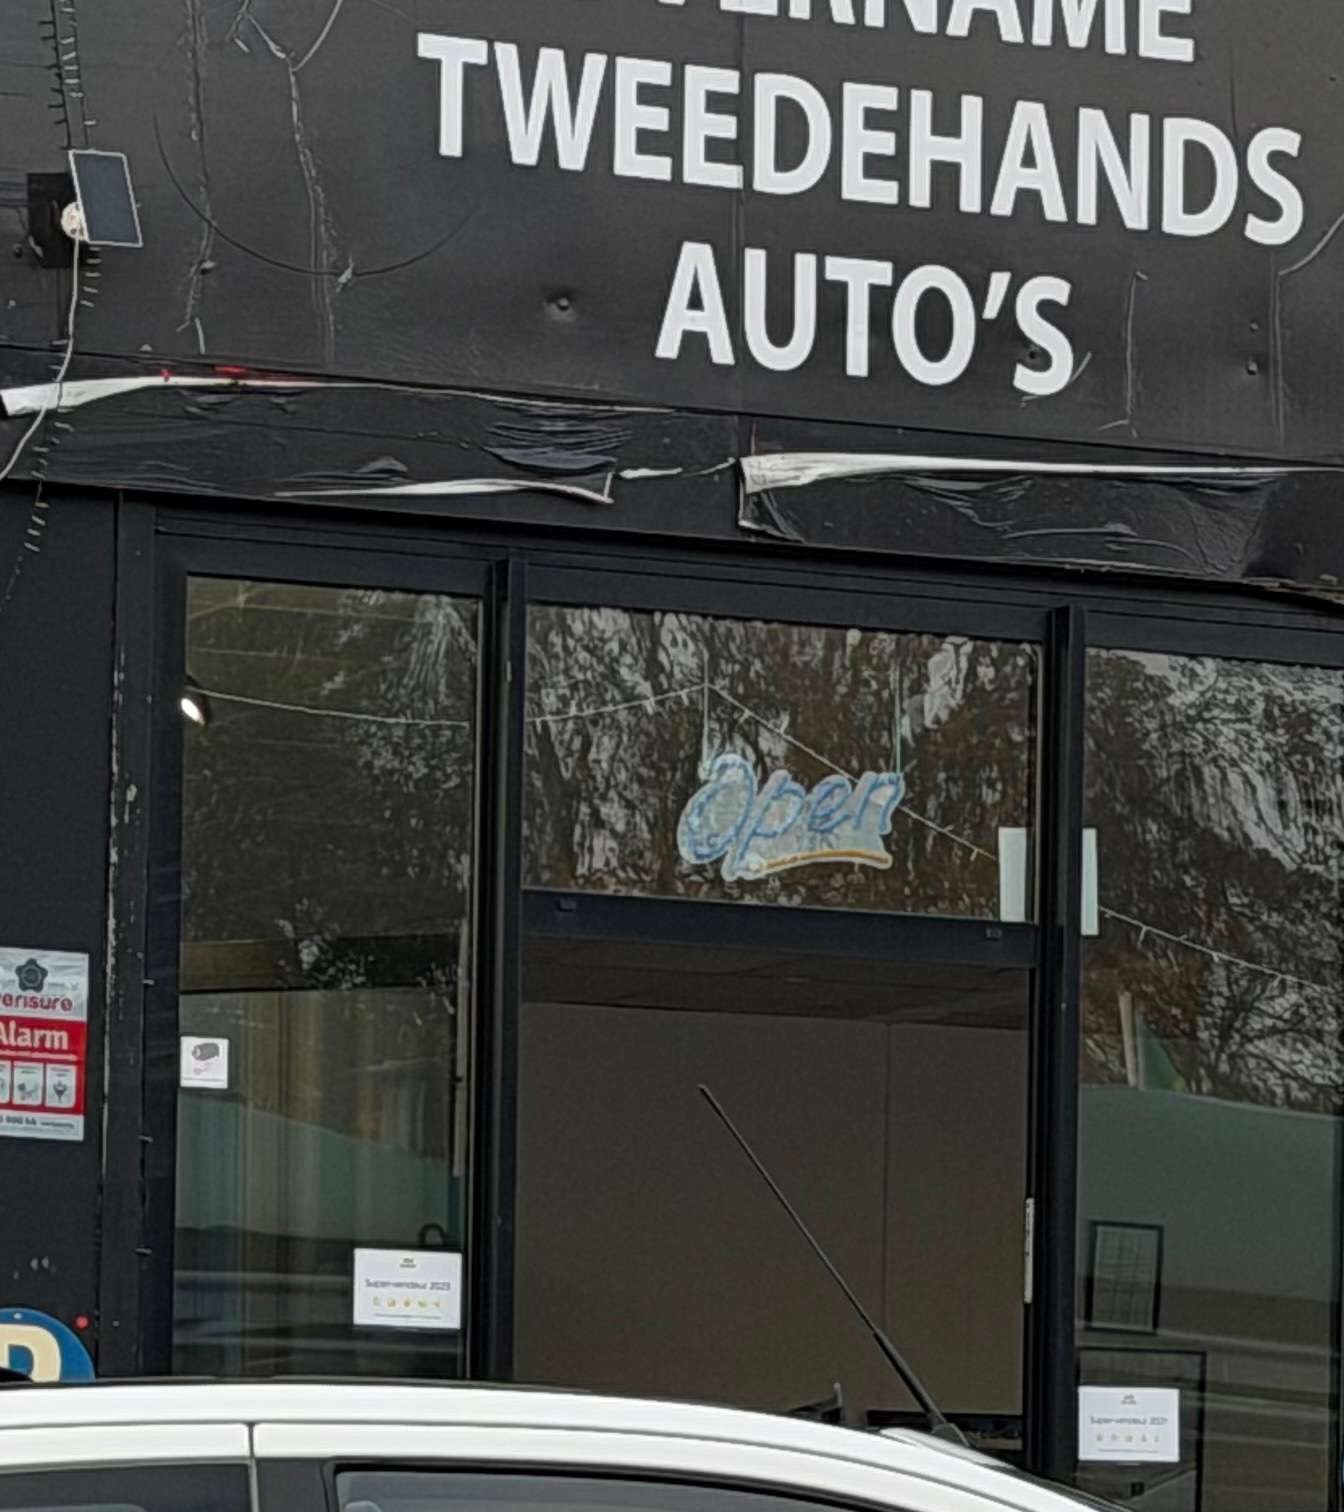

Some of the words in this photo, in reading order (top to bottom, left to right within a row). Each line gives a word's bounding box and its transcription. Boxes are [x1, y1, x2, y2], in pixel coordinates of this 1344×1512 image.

[417, 33, 1304, 246] TWEEDEHANDS
[654, 240, 1073, 395] AUTO'S
[683, 757, 902, 875] Open
